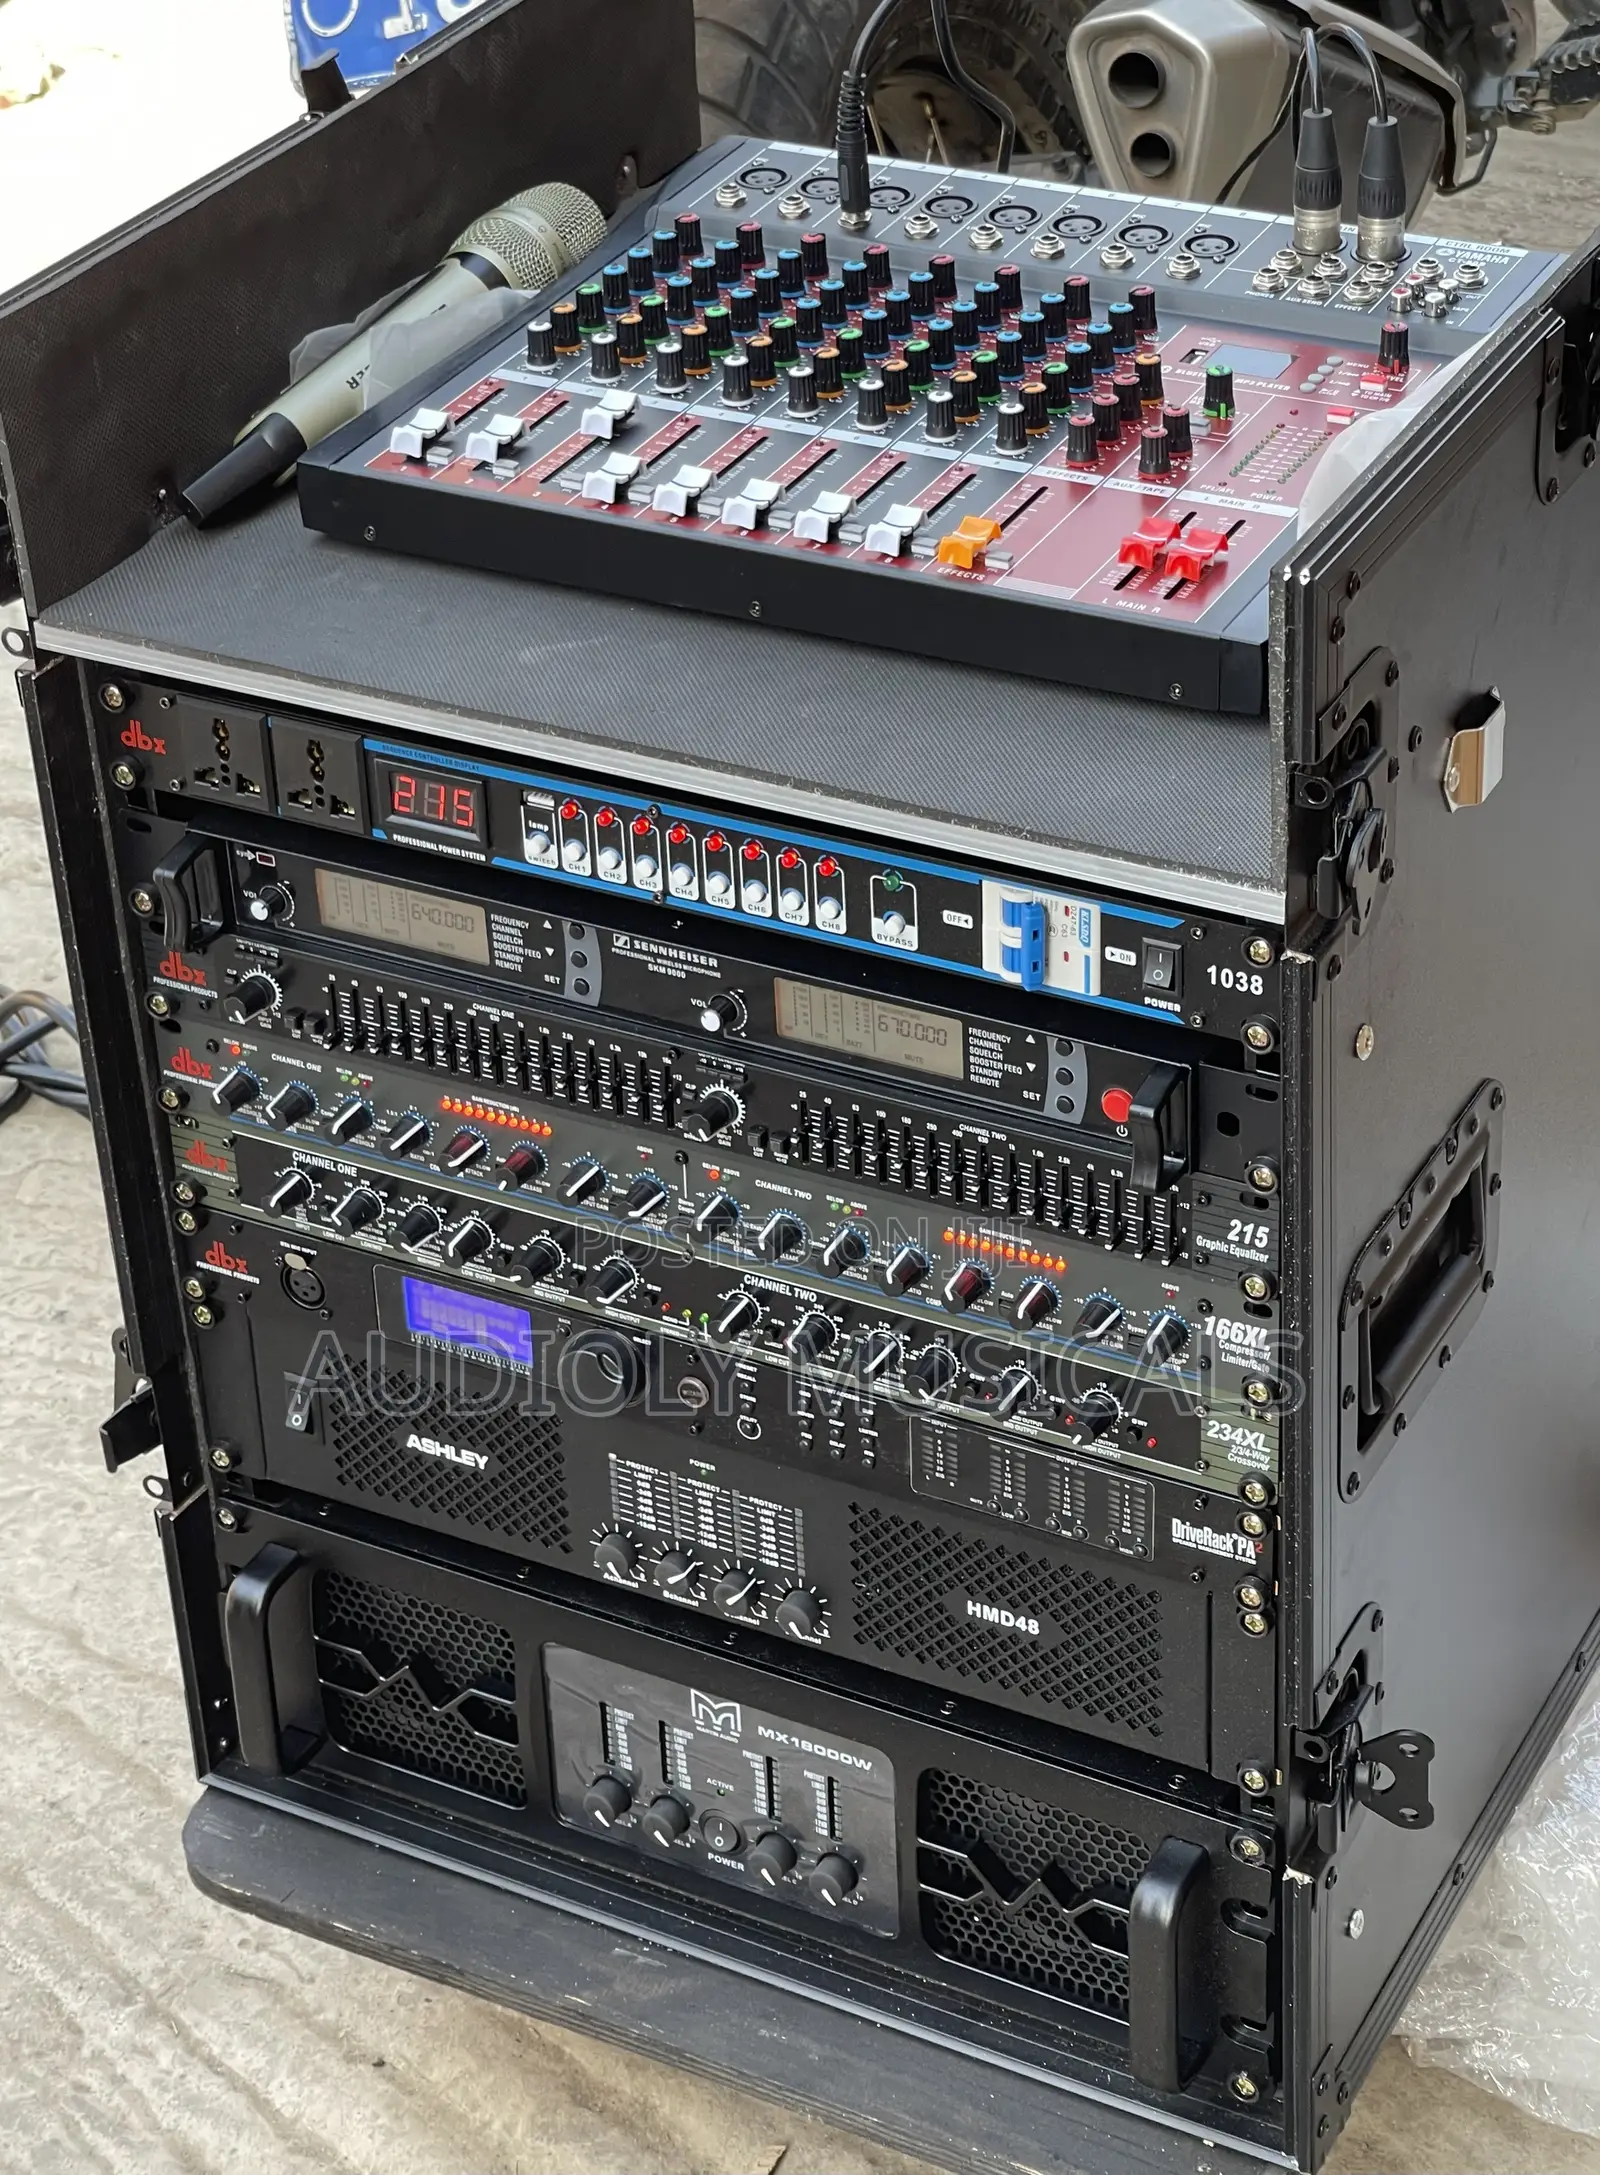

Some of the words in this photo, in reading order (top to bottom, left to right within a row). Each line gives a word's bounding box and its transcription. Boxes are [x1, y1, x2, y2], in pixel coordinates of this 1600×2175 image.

[1477, 244, 1511, 254] ROOM
[1454, 250, 1510, 265] YAMAHA
[1334, 303, 1363, 312] EFFECT
[1235, 378, 1259, 387] MP3
[1260, 381, 1291, 391] PLAYER
[1047, 470, 1088, 481] EFFECTS
[1219, 499, 1246, 507] MAIN
[1250, 492, 1283, 502] POWER
[937, 567, 985, 581] EFFECTS
[1116, 600, 1147, 611] MAIN
[121, 720, 166, 754] dbx
[392, 833, 438, 851] PROFESSIONAL
[438, 844, 461, 856] POWER
[461, 849, 486, 861] SYSTEM
[568, 863, 586, 873] CH1
[603, 871, 622, 881] CH2
[640, 879, 657, 888] CH3
[675, 887, 693, 897] CH4
[748, 904, 767, 913] CH6
[411, 903, 474, 934] 640.000
[491, 913, 530, 930] FREQUENCY
[785, 913, 803, 922] CH7
[946, 914, 962, 923] OFF
[492, 923, 523, 937] CHANNEL
[822, 921, 840, 931] CH8
[492, 932, 524, 946] SQUELCH
[877, 933, 913, 948] BYPASS
[493, 941, 525, 955] BOOSTER
[611, 947, 655, 963] PROFESSIONAL
[633, 939, 719, 968] SENNHEISER
[494, 950, 524, 964] STANDBY
[1119, 953, 1132, 963] ON
[160, 951, 207, 987] dbx
[495, 959, 523, 972] REMOTE
[648, 964, 666, 975] SKM
[544, 974, 561, 985] SET
[1206, 964, 1264, 996] 1038
[153, 976, 191, 993] PROFESSIONAL
[191, 985, 218, 999] PRODUCTS
[691, 998, 707, 1009] VOL
[1144, 996, 1181, 1013] POWER
[472, 1003, 500, 1017] CHANNEL
[501, 1010, 515, 1020] ONE
[877, 1014, 948, 1047] 670.000
[968, 1027, 1011, 1044] FREQUENCY
[968, 1036, 1003, 1052] CHANNEL
[969, 1046, 1003, 1061] SQUELCH
[171, 1046, 213, 1080] dbx
[271, 1053, 306, 1069] CHANNEL
[306, 1063, 322, 1073] ONE
[969, 1055, 1003, 1070] BOOSTER
[969, 1064, 1002, 1079] STANDBY
[969, 1074, 1000, 1088] REMOTE
[1022, 1090, 1041, 1101] SET
[958, 1123, 991, 1139] CHANNEL
[991, 1130, 1007, 1142] TWO
[184, 1139, 228, 1173] dbx
[292, 1151, 337, 1172] CHANNEL
[337, 1163, 358, 1177] ONE
[755, 1179, 793, 1195] CHANNEL
[794, 1189, 813, 1201] TWO
[1227, 1218, 1270, 1248] 215
[1196, 1235, 1229, 1254] Graphic
[1229, 1244, 1269, 1263] Equalizer
[205, 1240, 248, 1274] dbx
[744, 1274, 792, 1296] CHANNEL
[793, 1288, 818, 1303] TWO
[618, 1313, 641, 1324] OUTPUT
[1127, 1323, 1147, 1335] Bypass
[1204, 1315, 1271, 1352] 166XL
[1218, 1340, 1271, 1361] Compressor/
[765, 1355, 777, 1364] LOW
[778, 1358, 791, 1367] CUT
[1221, 1351, 1271, 1373] Limiter/Gate
[937, 1403, 960, 1414] OUTPUT
[1014, 1424, 1039, 1436] OUTPUT
[1206, 1419, 1272, 1454] 234XL
[406, 1433, 489, 1470] ASHLEY
[1097, 1448, 1122, 1460] OUTPUT
[1230, 1444, 1270, 1463] 2/3/4-Way
[626, 1460, 659, 1475] PROTECT
[689, 1458, 716, 1471] POWER
[1055, 1455, 1078, 1467] OUTPUT
[1227, 1452, 1271, 1473] Crossover
[634, 1471, 652, 1482] LIMIT
[687, 1478, 720, 1493] PROTECT
[695, 1489, 714, 1500] LIMIT
[749, 1496, 782, 1512] PROTECT
[756, 1507, 776, 1518] LIMIT
[1234, 1554, 1257, 1566] SYSTEM
[966, 1600, 1040, 1636] HMD48
[719, 1733, 739, 1744] AUDIO
[706, 1777, 735, 1792] ACTIVE
[708, 1852, 745, 1872] POWER
